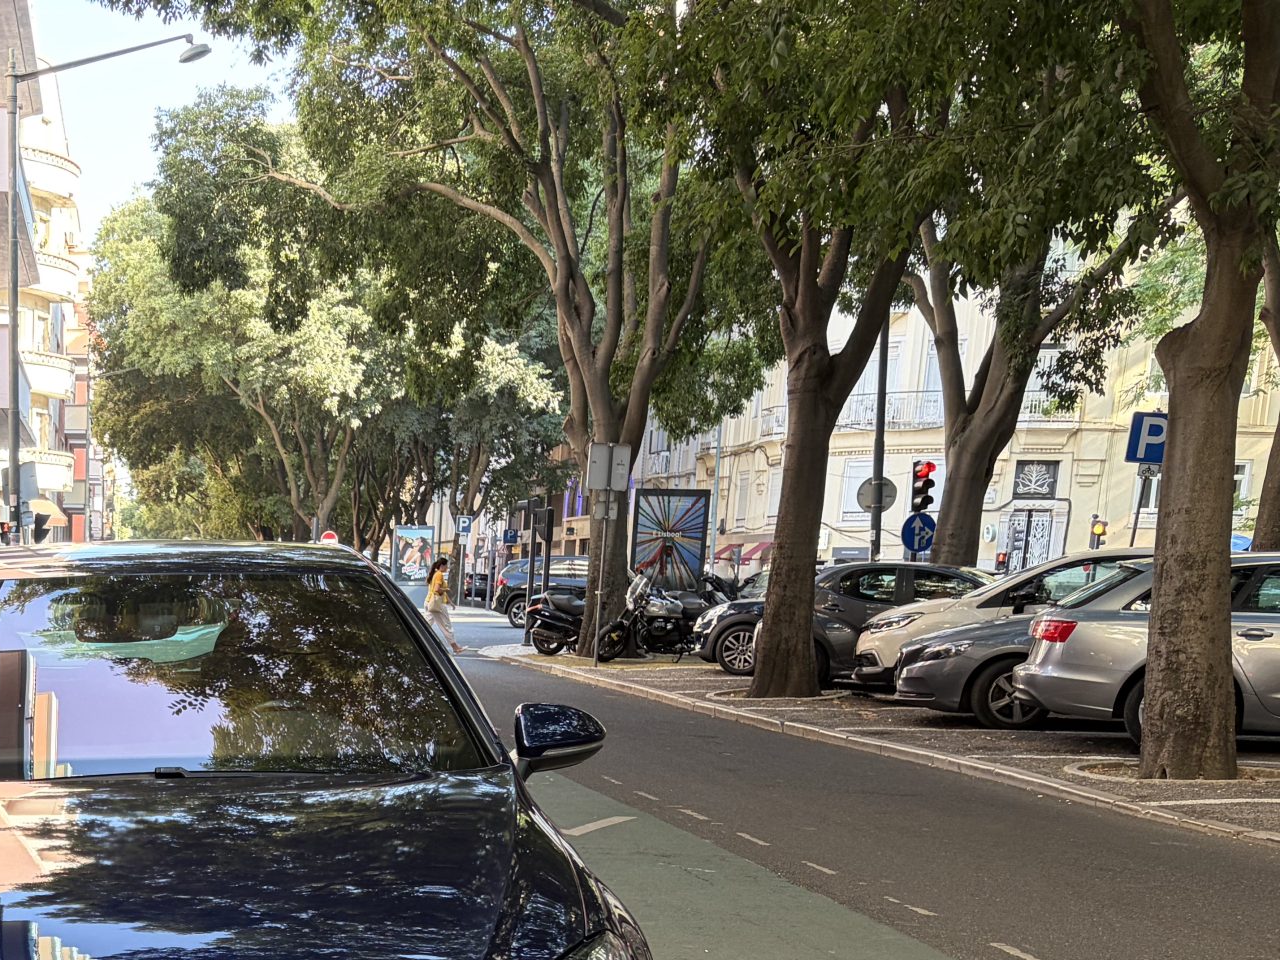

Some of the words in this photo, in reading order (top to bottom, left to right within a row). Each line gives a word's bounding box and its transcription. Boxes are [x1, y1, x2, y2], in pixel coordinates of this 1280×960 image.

[1136, 416, 1169, 459] P
[459, 517, 470, 532] P
[507, 530, 516, 541] P
